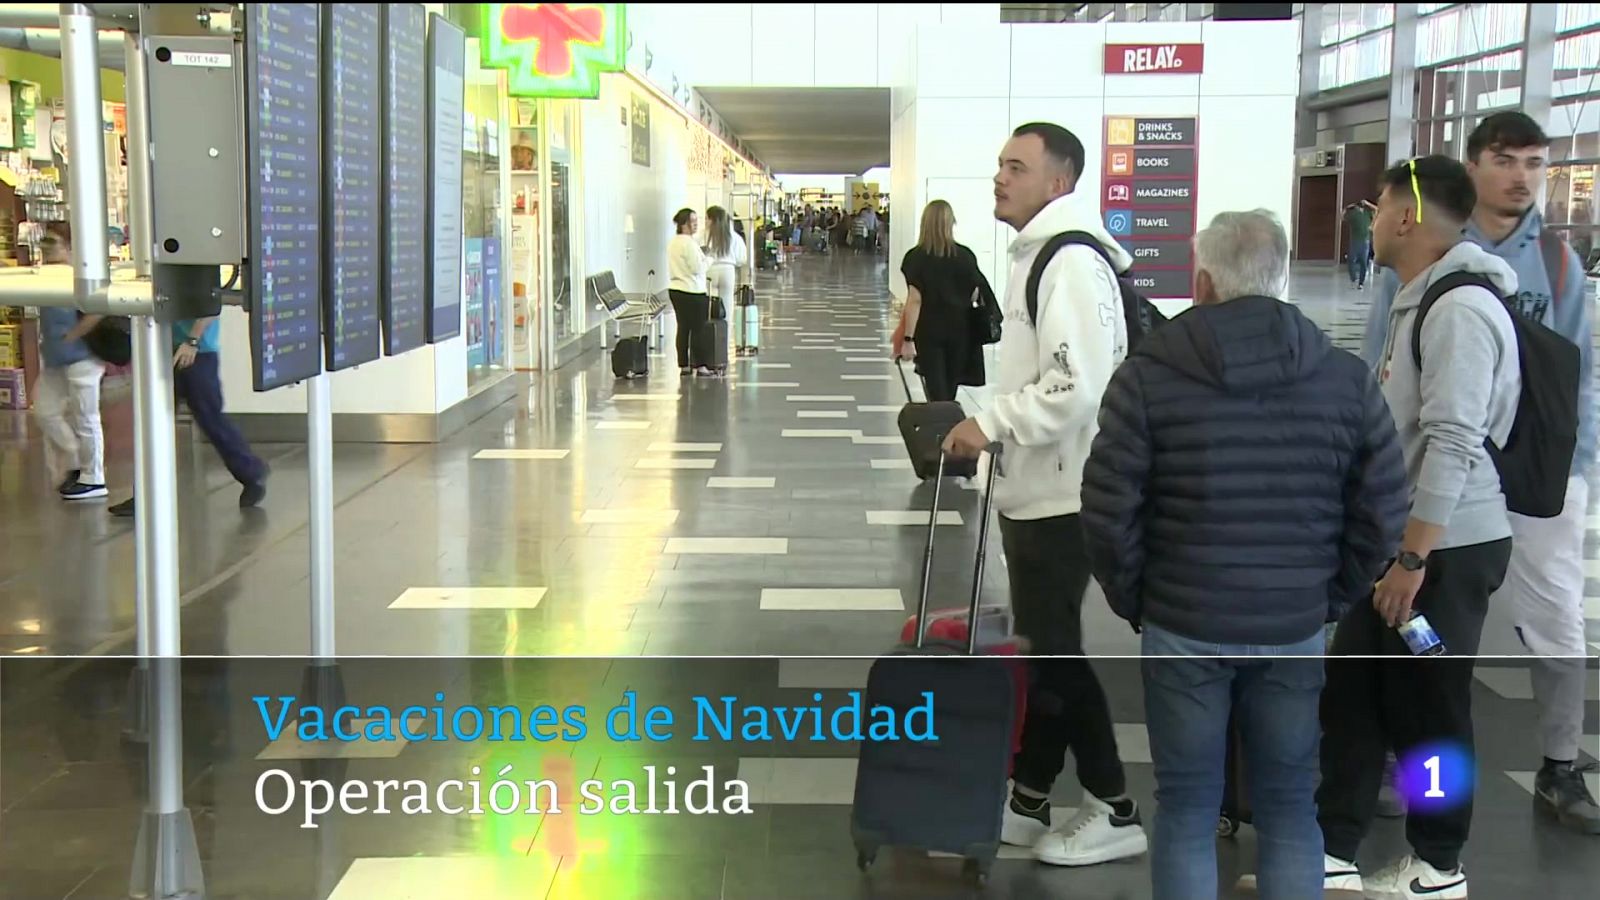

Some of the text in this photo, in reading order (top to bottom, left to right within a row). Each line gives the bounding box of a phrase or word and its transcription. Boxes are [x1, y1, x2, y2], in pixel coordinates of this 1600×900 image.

[1123, 46, 1177, 72] RELAY
[1138, 123, 1173, 132] DRINKS
[1138, 132, 1183, 141] & SNACKS
[1136, 157, 1169, 168] BOOKS
[1136, 188, 1190, 198] MAGAZINES
[1135, 218, 1170, 228] TRAVEL
[1134, 248, 1160, 258] GIFTS
[1133, 278, 1156, 288] KIDS
